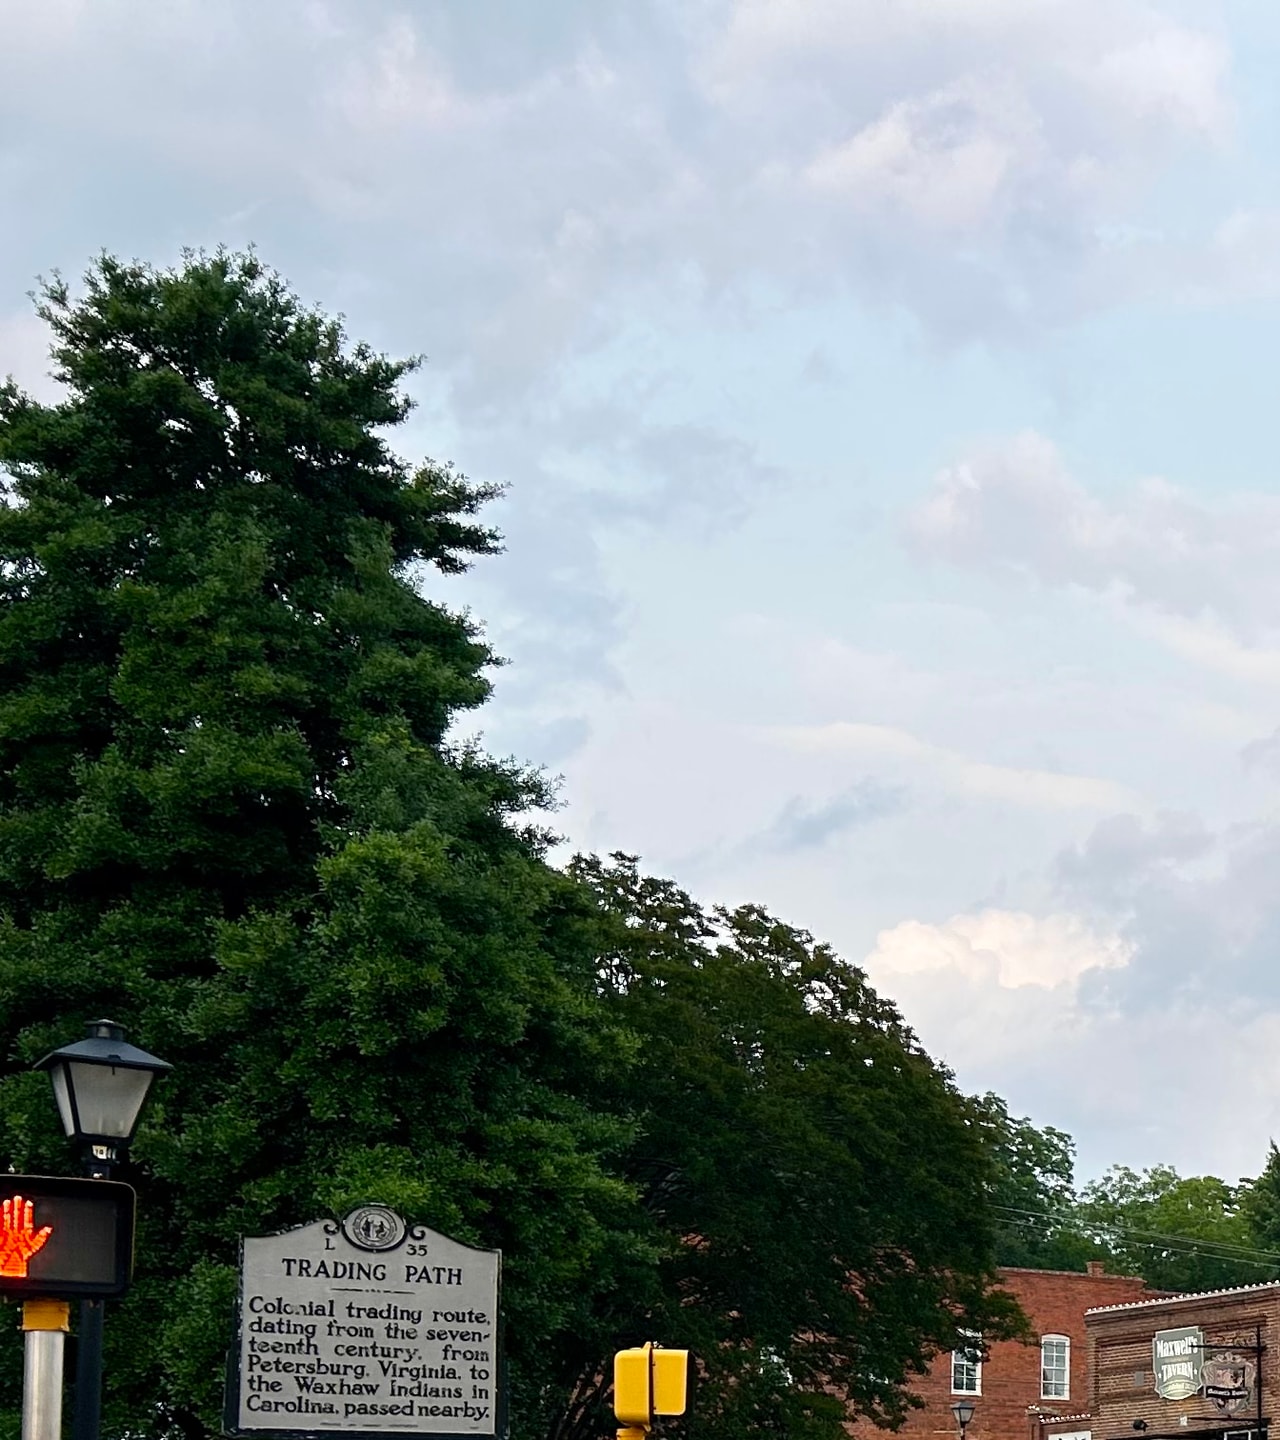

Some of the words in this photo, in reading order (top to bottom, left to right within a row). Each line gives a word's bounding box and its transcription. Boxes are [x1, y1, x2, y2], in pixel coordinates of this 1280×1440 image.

[325, 1238, 336, 1250] L
[406, 1244, 428, 1256] 35
[282, 1258, 386, 1281] TRADING
[405, 1265, 462, 1285] PATH
[249, 1295, 335, 1317] Colonial
[345, 1301, 422, 1324] trading
[432, 1308, 490, 1326] route,
[249, 1316, 317, 1338] dating
[327, 1319, 374, 1338] from
[384, 1322, 418, 1340] the
[426, 1329, 490, 1342] seven-
[248, 1335, 319, 1355] teenth
[442, 1344, 490, 1361] from
[1156, 1336, 1198, 1358] Maxwell's
[469, 1364, 490, 1380] to
[1161, 1361, 1194, 1382] TAVERN
[247, 1375, 283, 1392] the
[293, 1376, 380, 1395] Waxhaw
[390, 1380, 463, 1398] Indians
[472, 1385, 489, 1399] in
[247, 1394, 339, 1415] Carolina,
[344, 1400, 414, 1419] passed
[417, 1401, 490, 1421] nearby.
